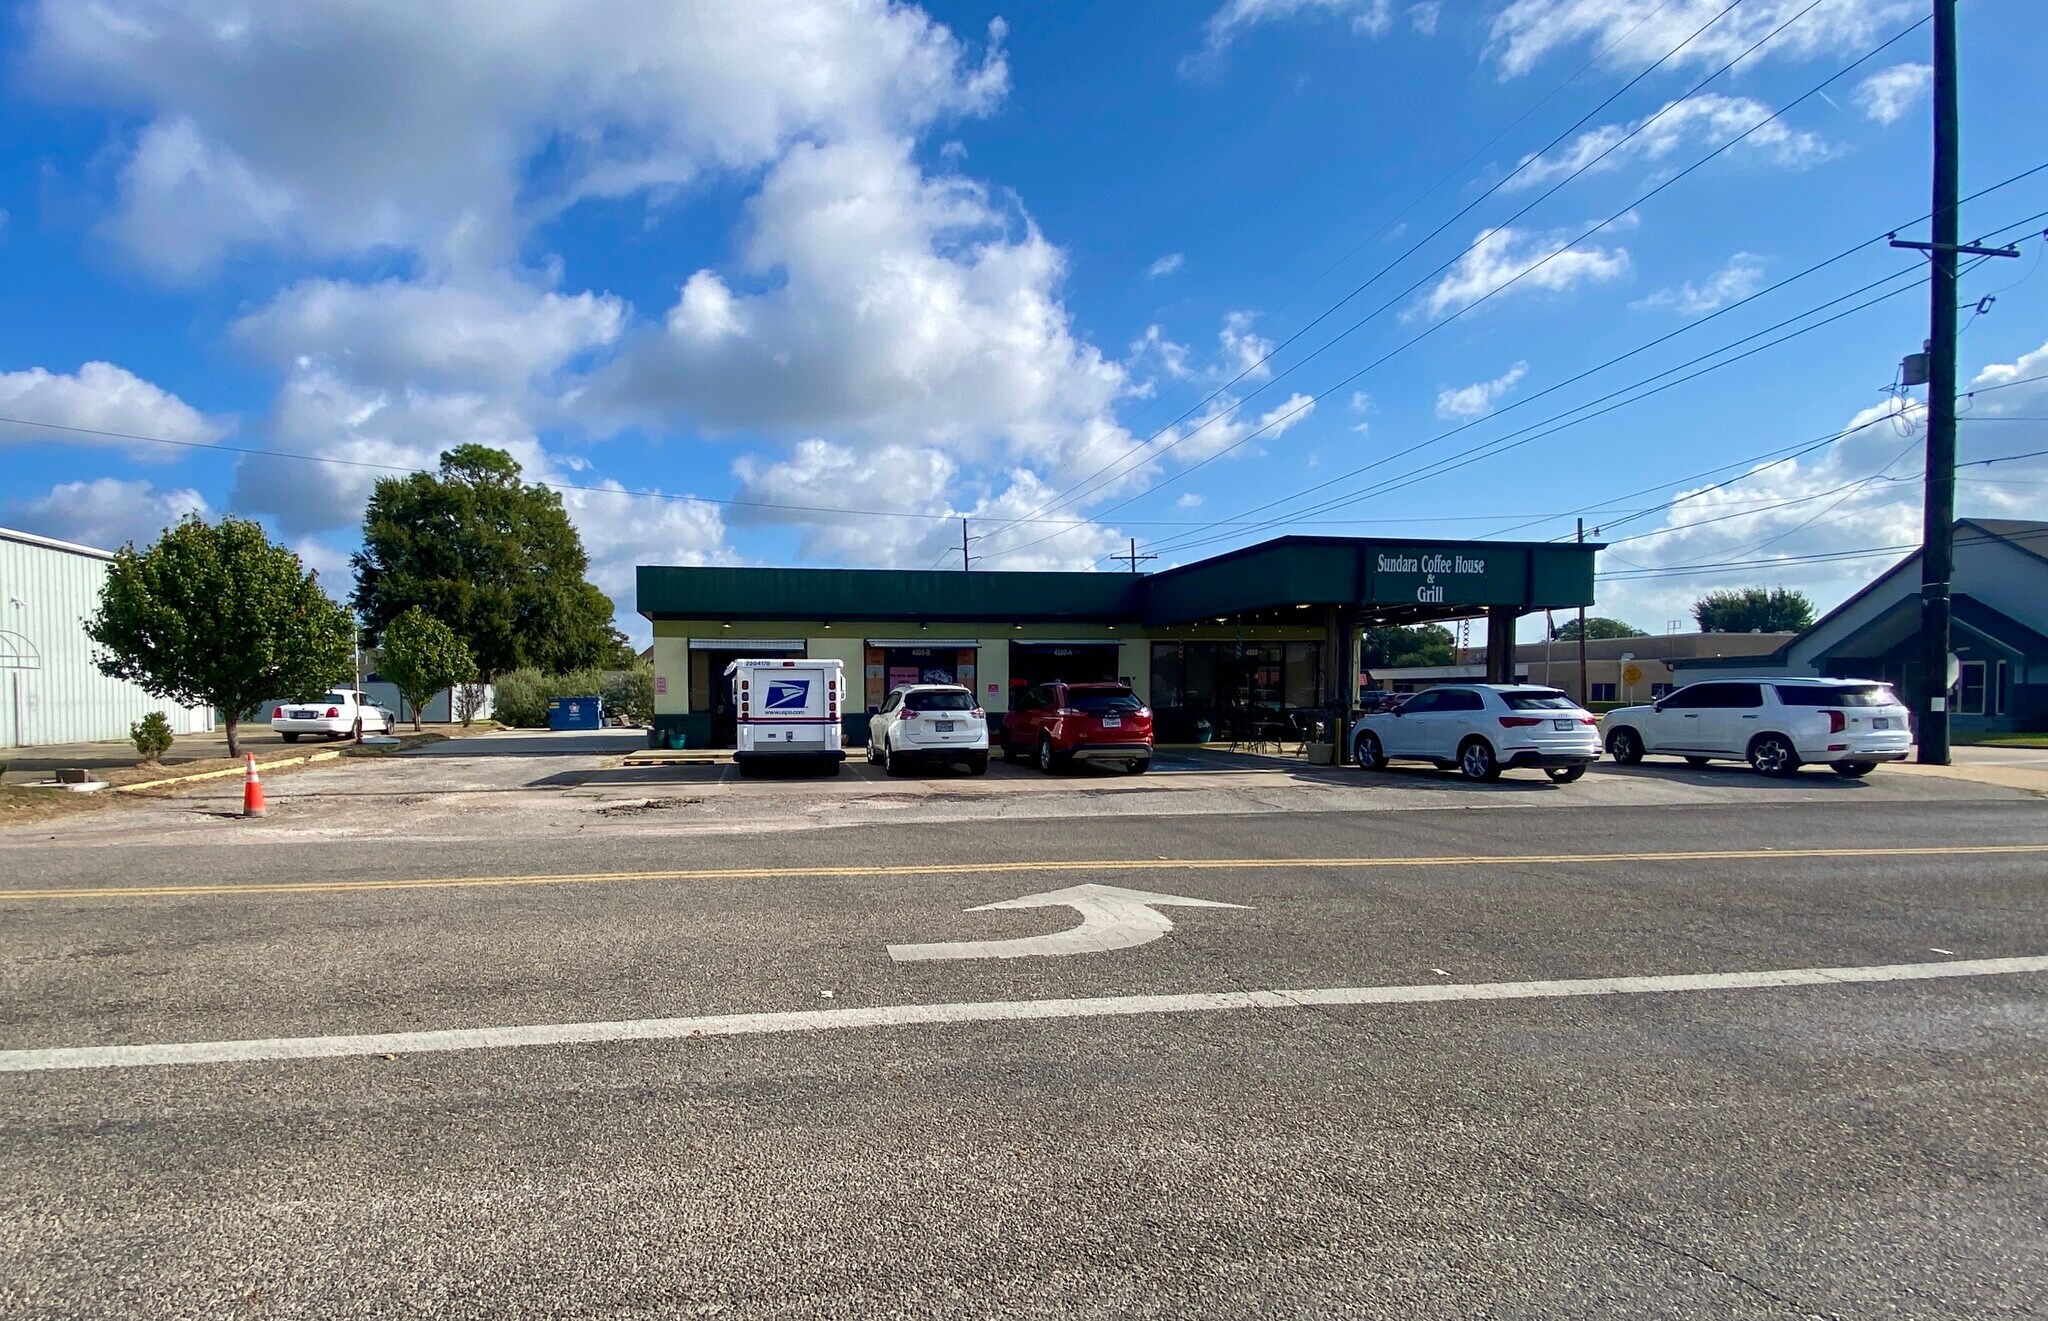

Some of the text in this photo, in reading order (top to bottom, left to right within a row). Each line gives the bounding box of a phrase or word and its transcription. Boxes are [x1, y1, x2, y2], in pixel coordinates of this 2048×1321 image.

[1377, 554, 1485, 574] Sundara Coffee House
[1426, 574, 1435, 583] &
[1417, 585, 1444, 603] Grill
[912, 648, 931, 656] 4000-B
